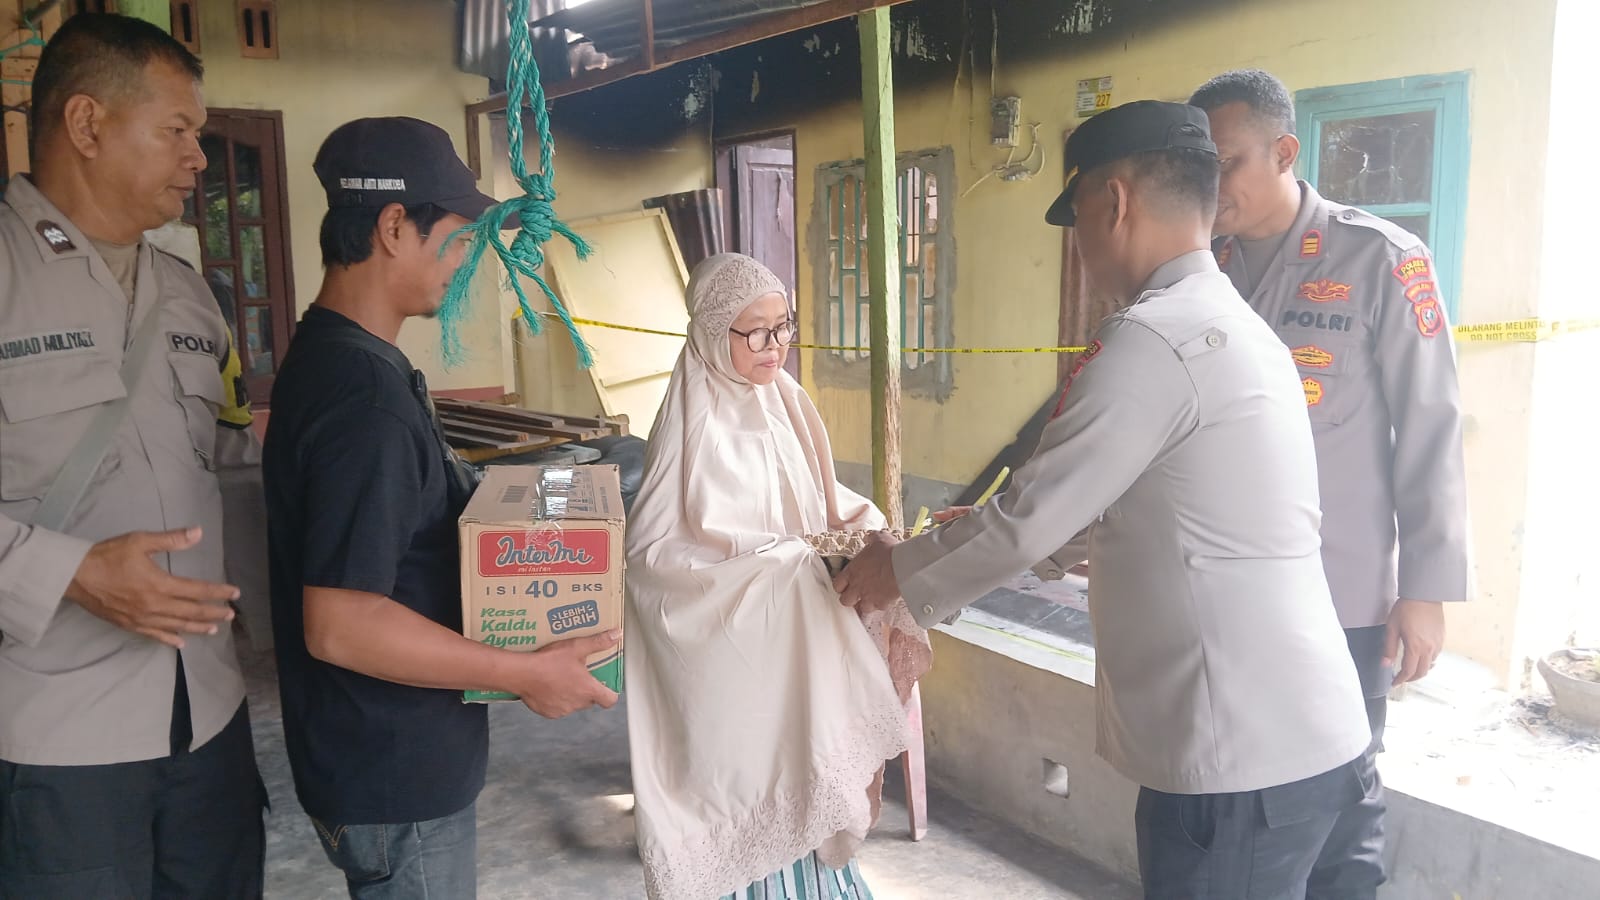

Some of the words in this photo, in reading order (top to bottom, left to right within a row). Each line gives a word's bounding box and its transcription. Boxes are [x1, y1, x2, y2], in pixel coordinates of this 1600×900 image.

[1096, 93, 1111, 107] 227
[1282, 310, 1352, 332] POLRI
[1458, 322, 1502, 333] DILARANG
[1505, 319, 1545, 330] MELINT
[1470, 333, 1484, 342] DO
[1486, 332, 1503, 341] NOT
[1506, 331, 1537, 340] CROSS
[496, 536, 594, 567] InterMi
[485, 585, 517, 596] ISI
[525, 579, 559, 599] 40
[571, 583, 604, 593] BKS
[480, 607, 528, 618] Rasa
[558, 604, 586, 620] LEBIH
[480, 618, 537, 633] Kaldu
[551, 611, 597, 632] GURIH
[481, 633, 537, 649] Ayam
